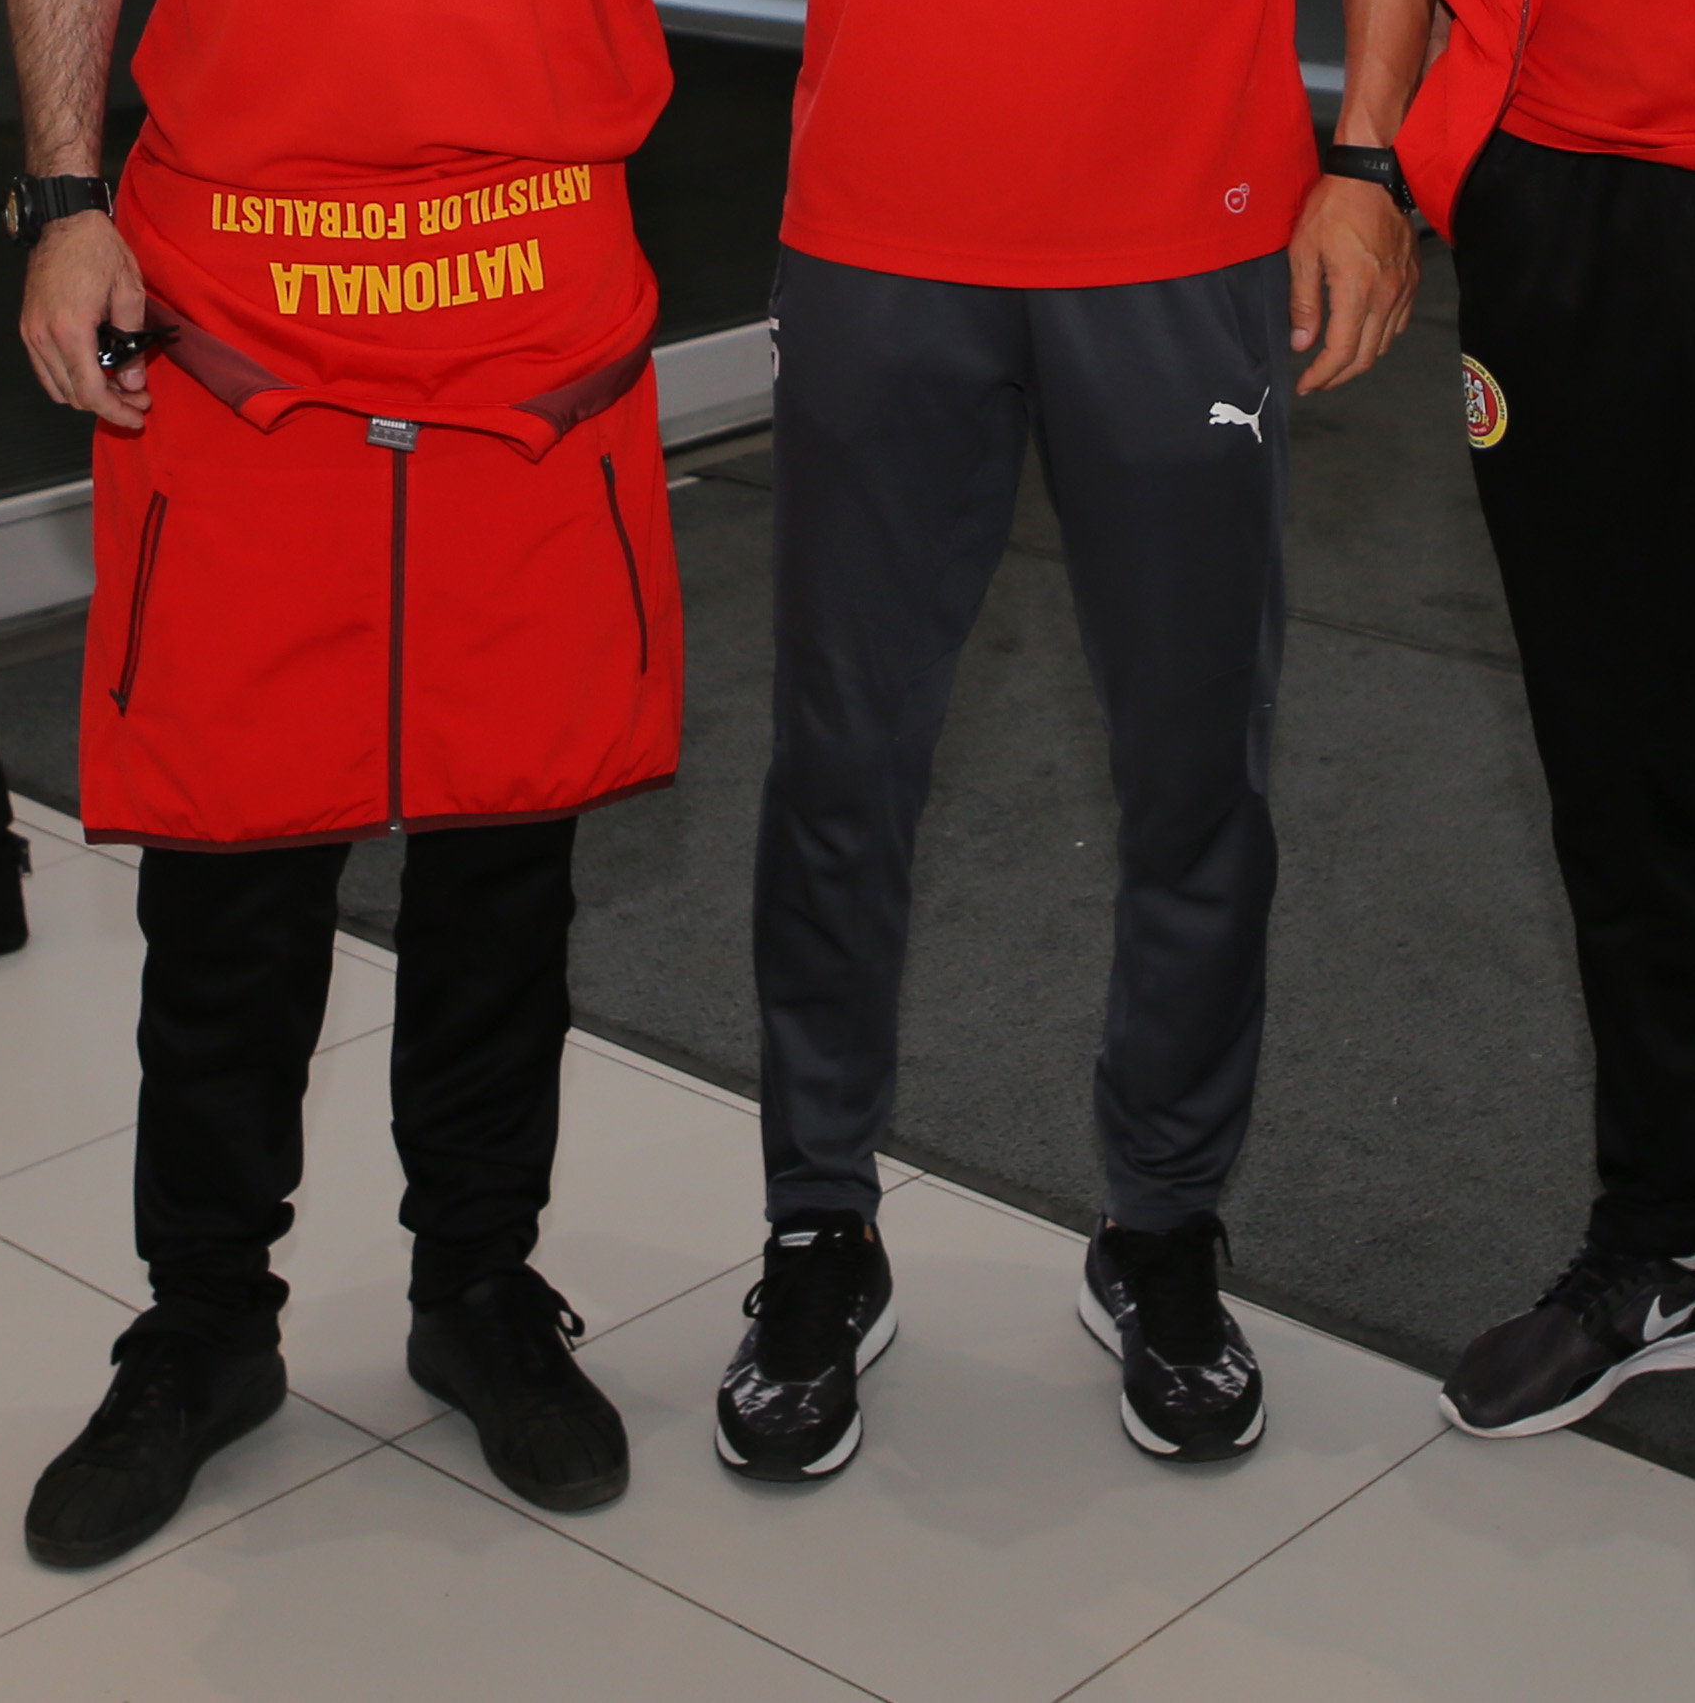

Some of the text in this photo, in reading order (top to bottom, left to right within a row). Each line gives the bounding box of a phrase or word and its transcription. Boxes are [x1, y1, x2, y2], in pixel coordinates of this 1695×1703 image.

[212, 165, 592, 240] ARTISTILOR FOTBALISTI
[269, 238, 545, 316] NATIONALA
